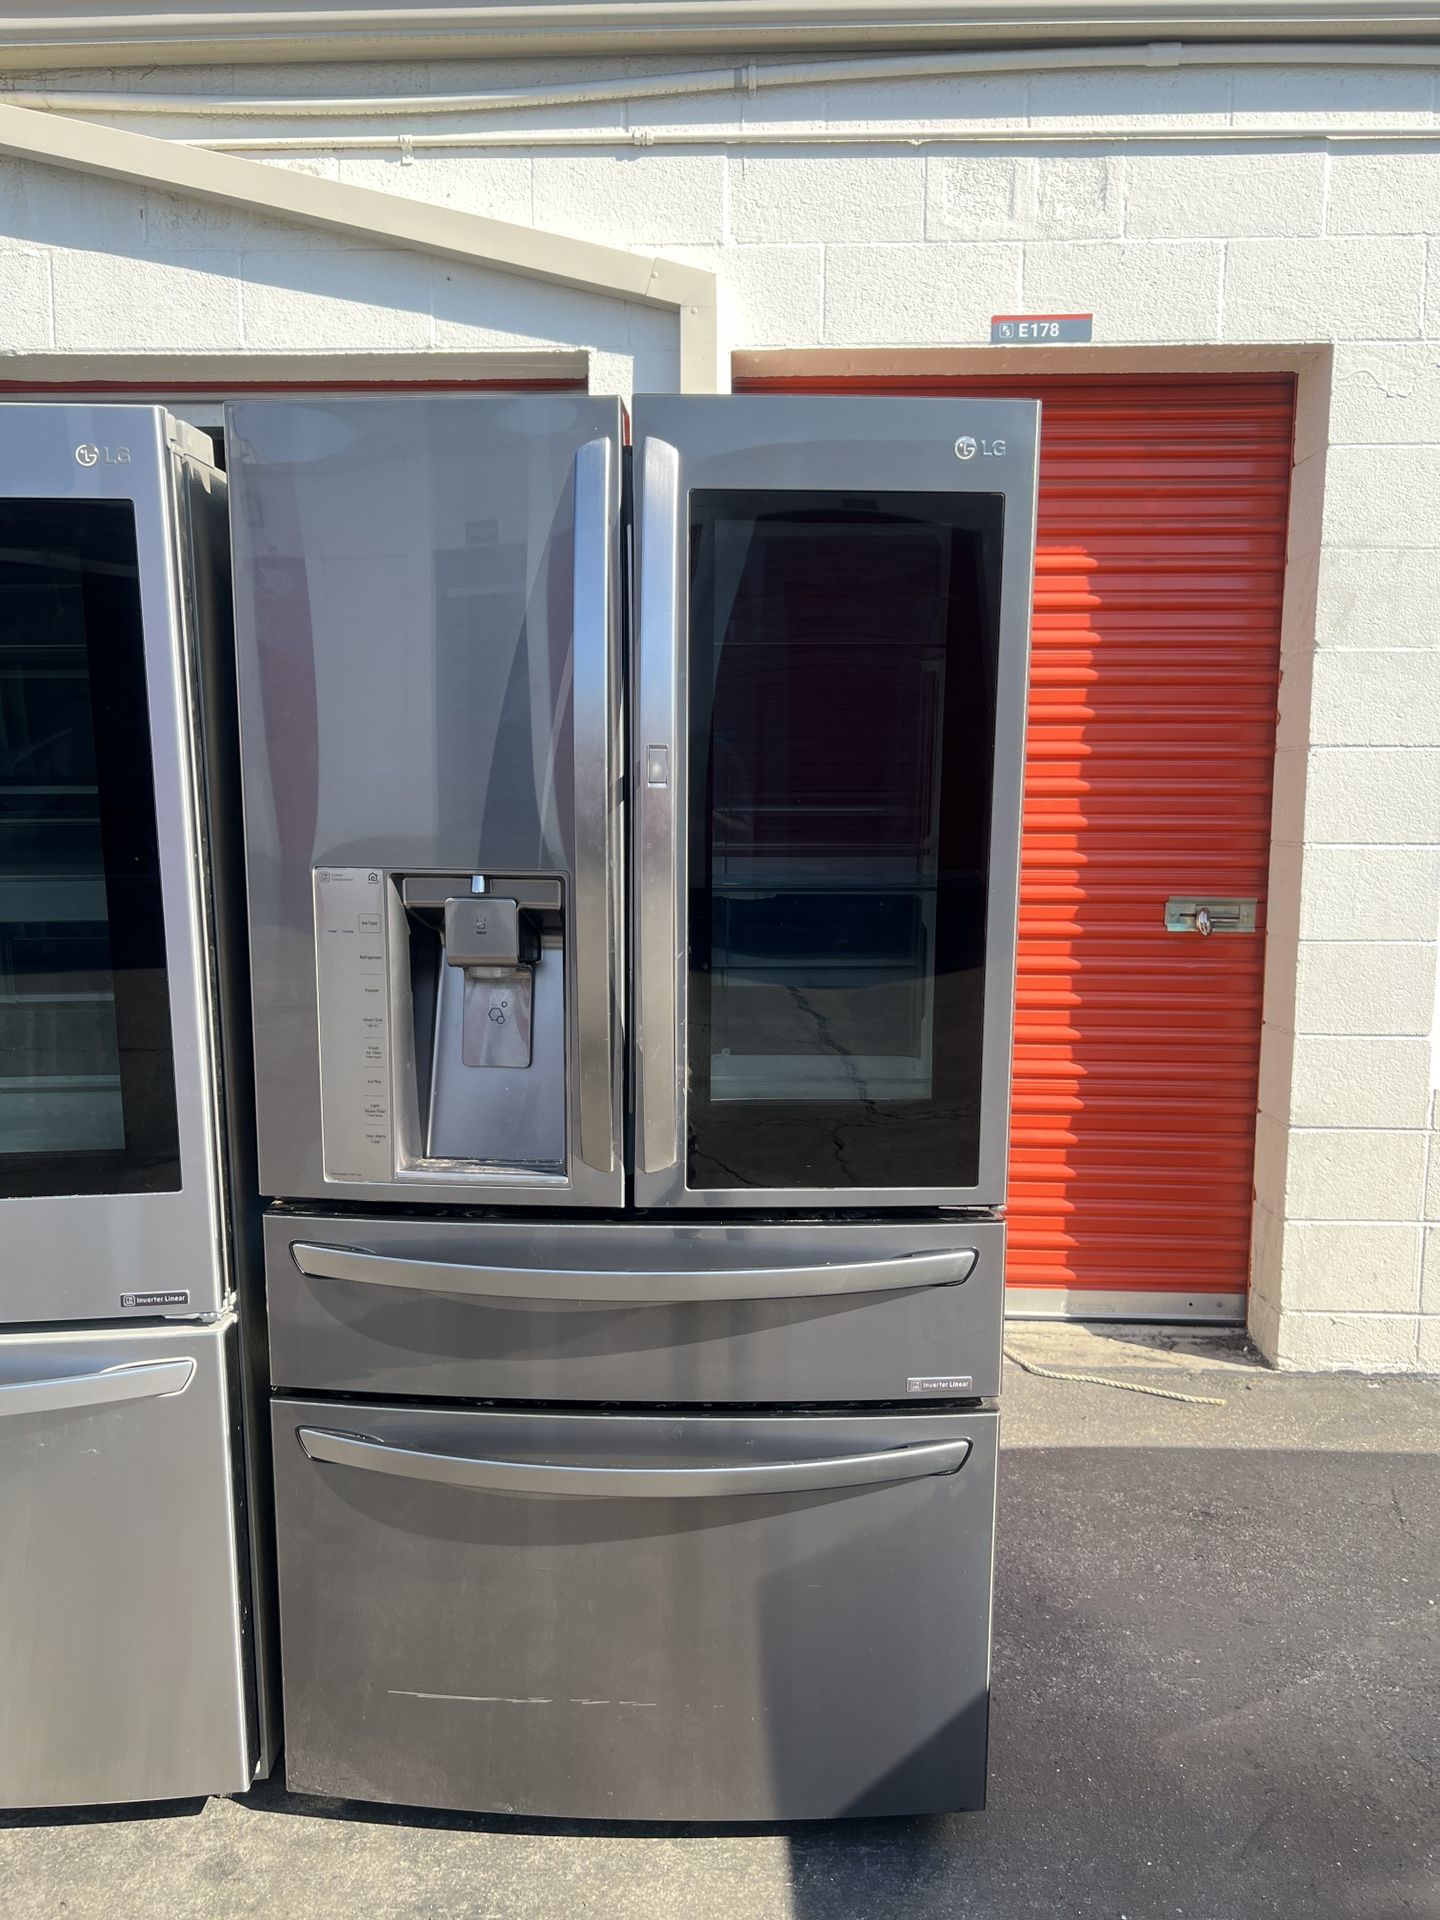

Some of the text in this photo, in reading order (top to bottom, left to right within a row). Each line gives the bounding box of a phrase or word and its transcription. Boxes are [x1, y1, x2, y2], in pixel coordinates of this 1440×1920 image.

[1018, 322, 1060, 338] E178
[103, 446, 132, 465] LG
[981, 439, 1006, 457] LG
[136, 1296, 164, 1304] Inverter
[164, 1294, 186, 1302] Linear
[923, 1381, 949, 1389] Inverter
[949, 1380, 969, 1388] Linear
